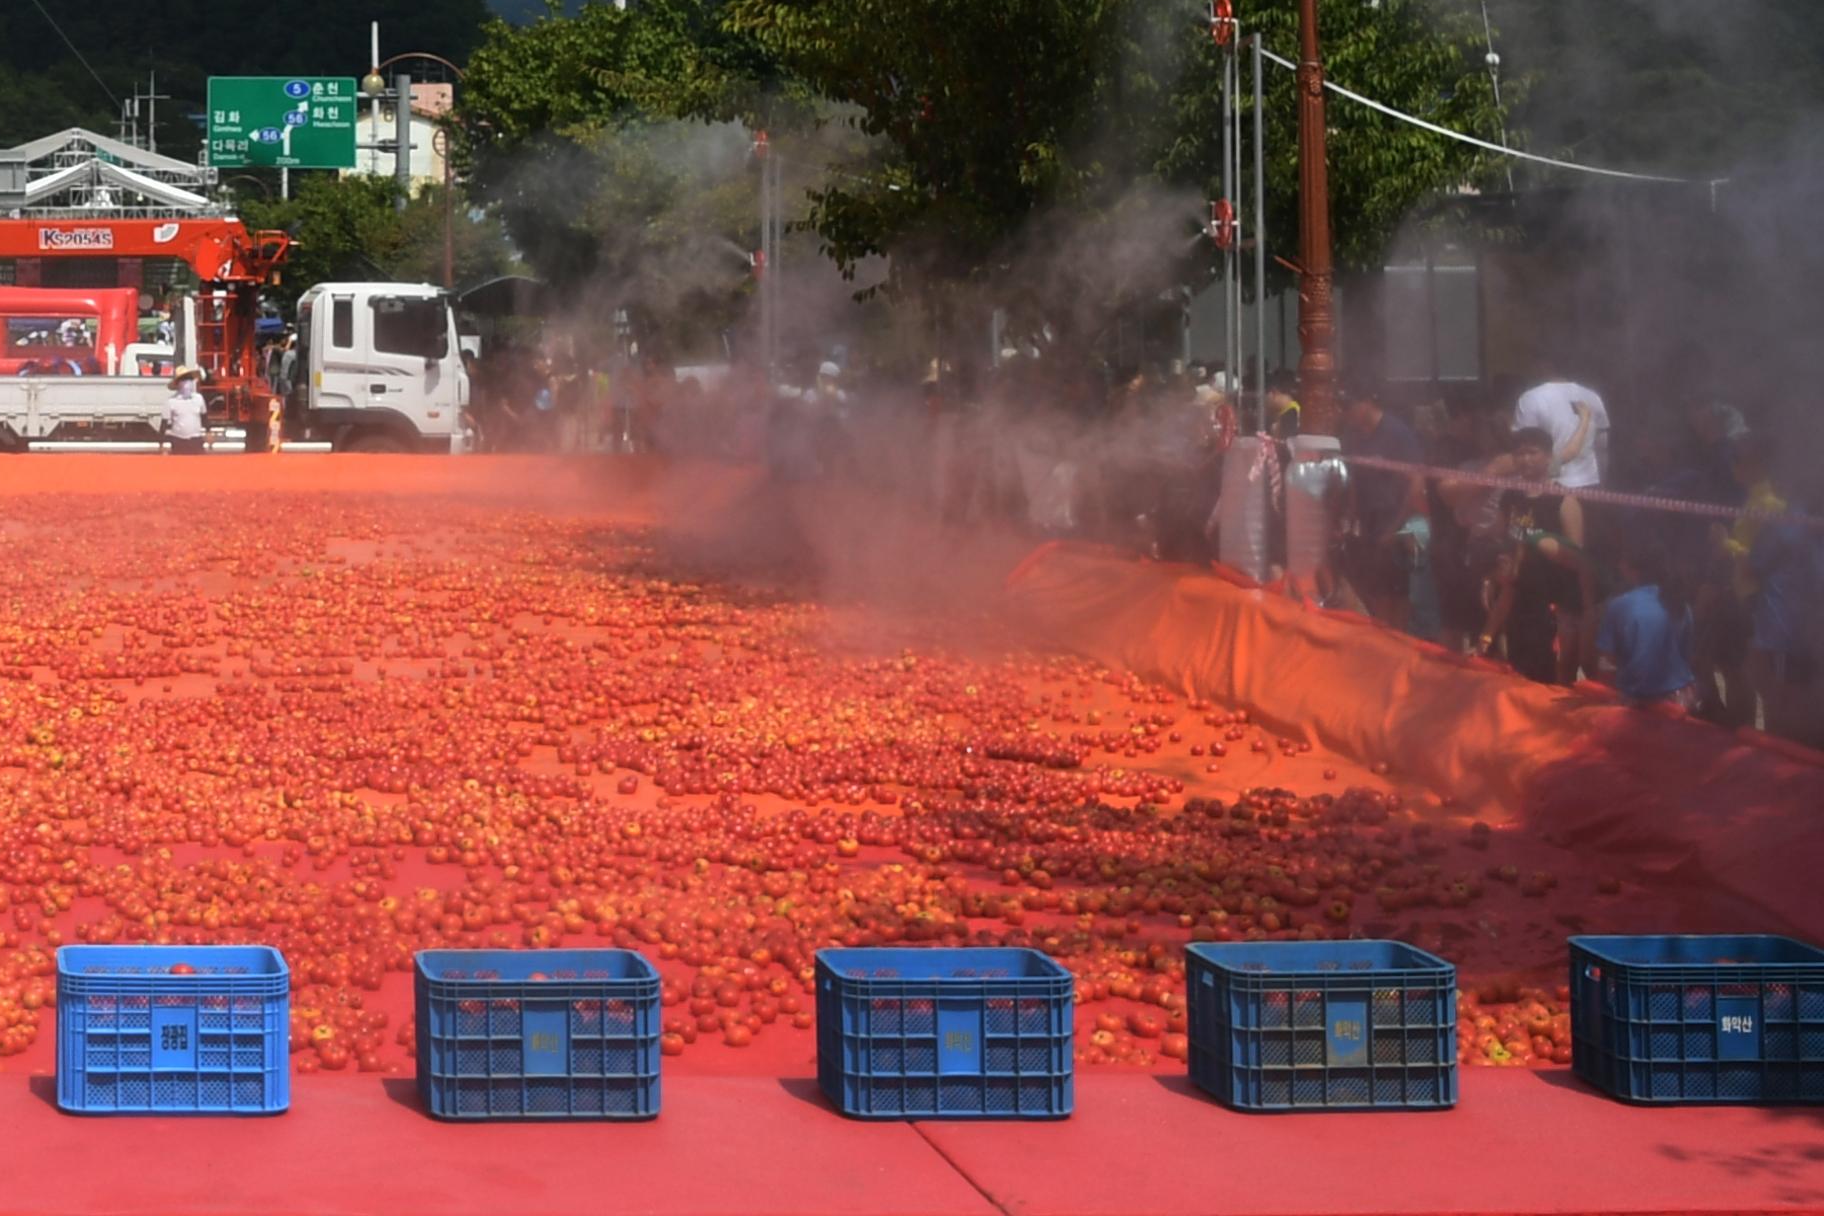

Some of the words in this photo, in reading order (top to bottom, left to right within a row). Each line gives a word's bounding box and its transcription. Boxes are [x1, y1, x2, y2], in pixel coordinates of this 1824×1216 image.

[292, 83, 302, 95] 5
[312, 81, 339, 95] 춘천
[287, 112, 304, 124] 56
[312, 106, 339, 120] 화천
[262, 130, 277, 141] 56
[1721, 1015, 1752, 1033] 화악산
